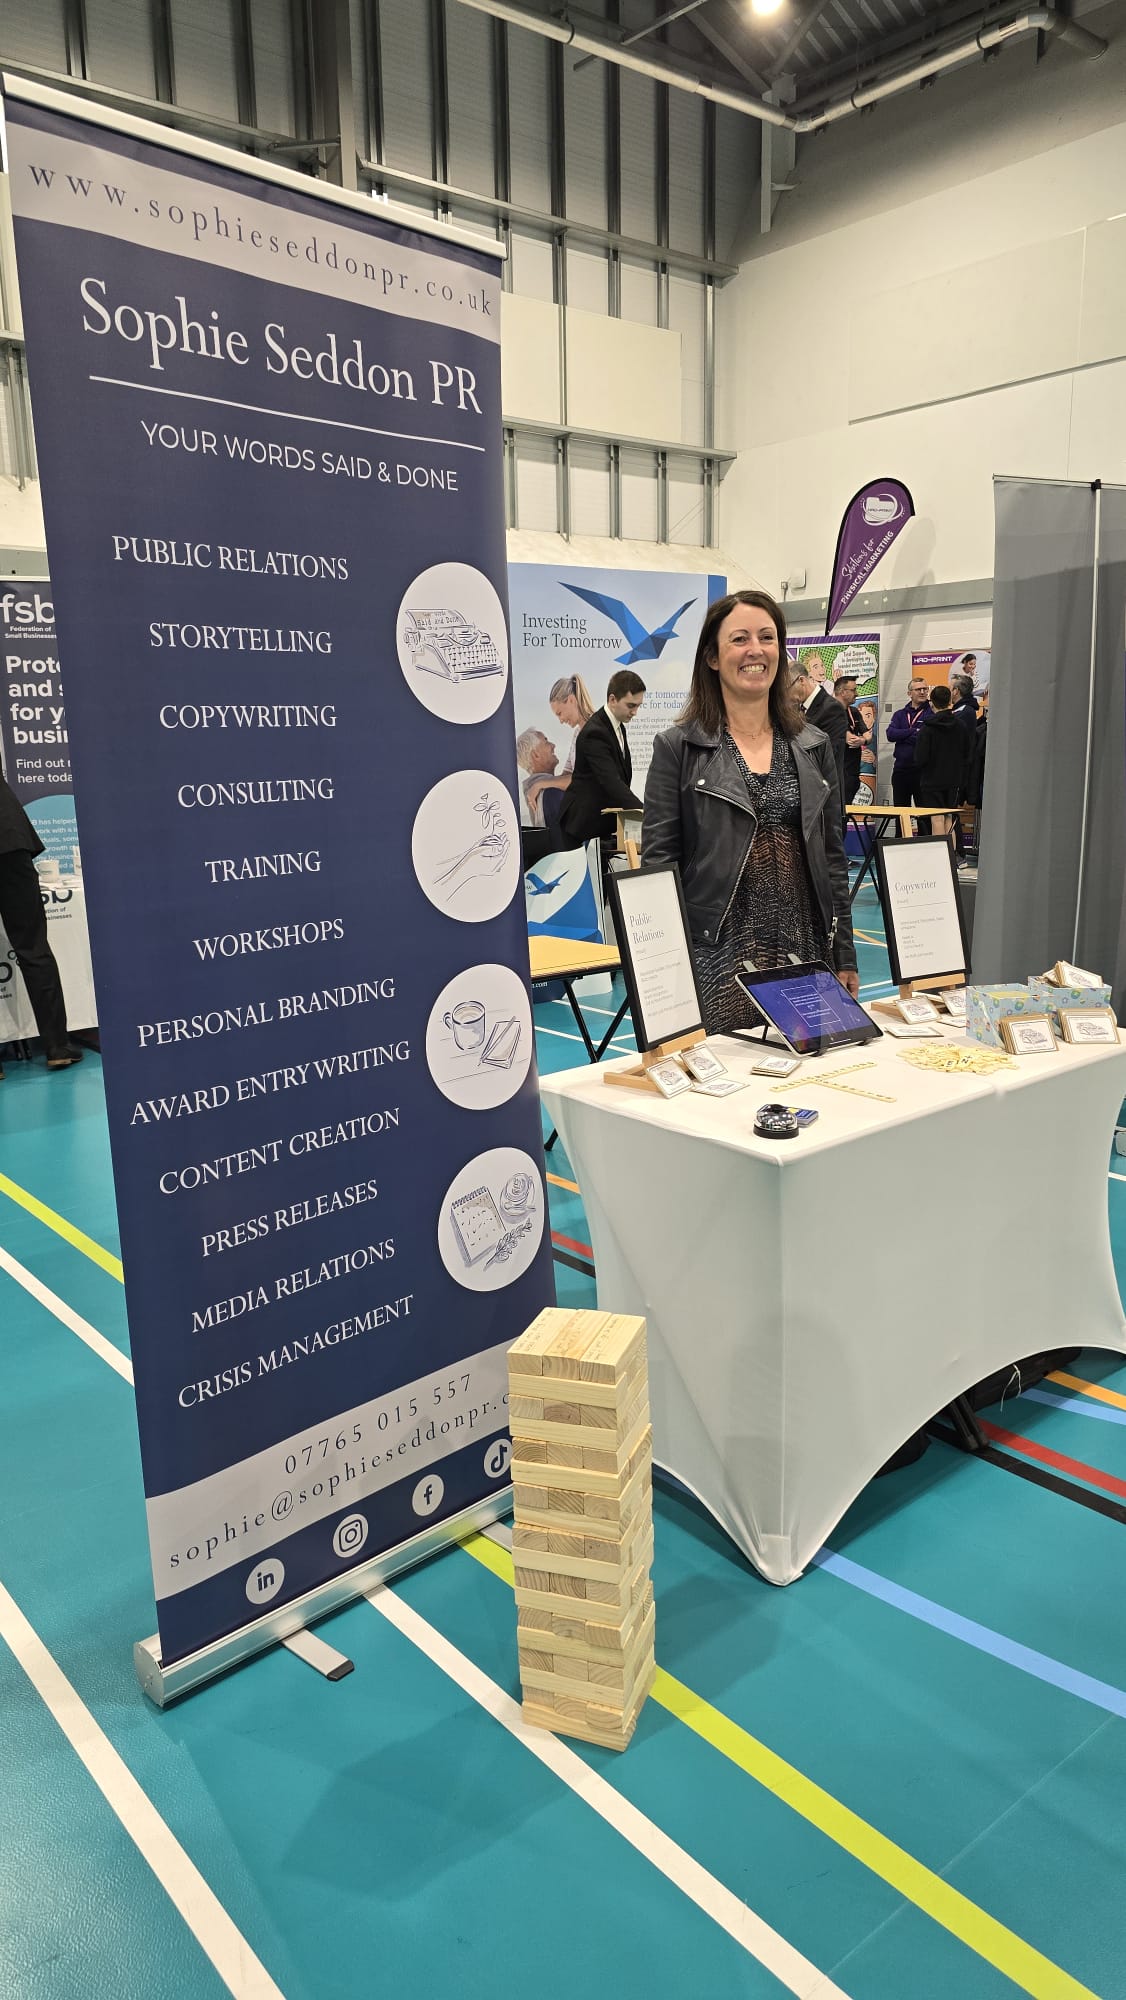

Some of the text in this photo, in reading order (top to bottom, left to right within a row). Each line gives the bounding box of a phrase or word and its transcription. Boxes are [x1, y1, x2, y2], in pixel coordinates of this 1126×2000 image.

[28, 163, 492, 316] www.sophieseddonpr.co.uk
[80, 277, 483, 415] Sophie Seddon PR
[141, 420, 459, 491] YOUR WORDS SAID & DONE
[112, 535, 349, 581] PUBLIC RELATIONS
[841, 530, 894, 604] PHYSICAL MARKETING
[149, 622, 333, 654] STORYTELLING
[522, 613, 587, 634] Investing
[523, 633, 622, 649] For Tomorrow
[9, 679, 53, 697] and
[650, 700, 661, 709] for
[655, 691, 689, 699] tomorro
[10, 703, 43, 721] for
[159, 704, 337, 729] COPYWRITING
[16, 759, 42, 768] Find
[45, 759, 65, 768] out
[18, 772, 72, 783] here toda
[177, 777, 334, 808] CONSULTING
[205, 850, 321, 883] TRAINING
[895, 880, 937, 894] Copywriter
[629, 912, 652, 928] Public
[632, 928, 665, 945] Relations
[193, 918, 344, 961] WORKSHOPS
[137, 978, 396, 1047] PERSONAL BRANDING
[130, 1040, 411, 1126] AWARD ENTRY WRITING
[158, 1107, 401, 1194] CONTENT CREATION
[201, 1179, 379, 1257] PRESS RELEASES
[191, 1238, 396, 1333] MEDIA RELATIONS
[178, 1294, 415, 1409] CRISIS MANAGEMENT
[285, 1374, 472, 1475] 07765 015 557
[170, 1392, 509, 1568] sophie@sophieseddonpr.c
